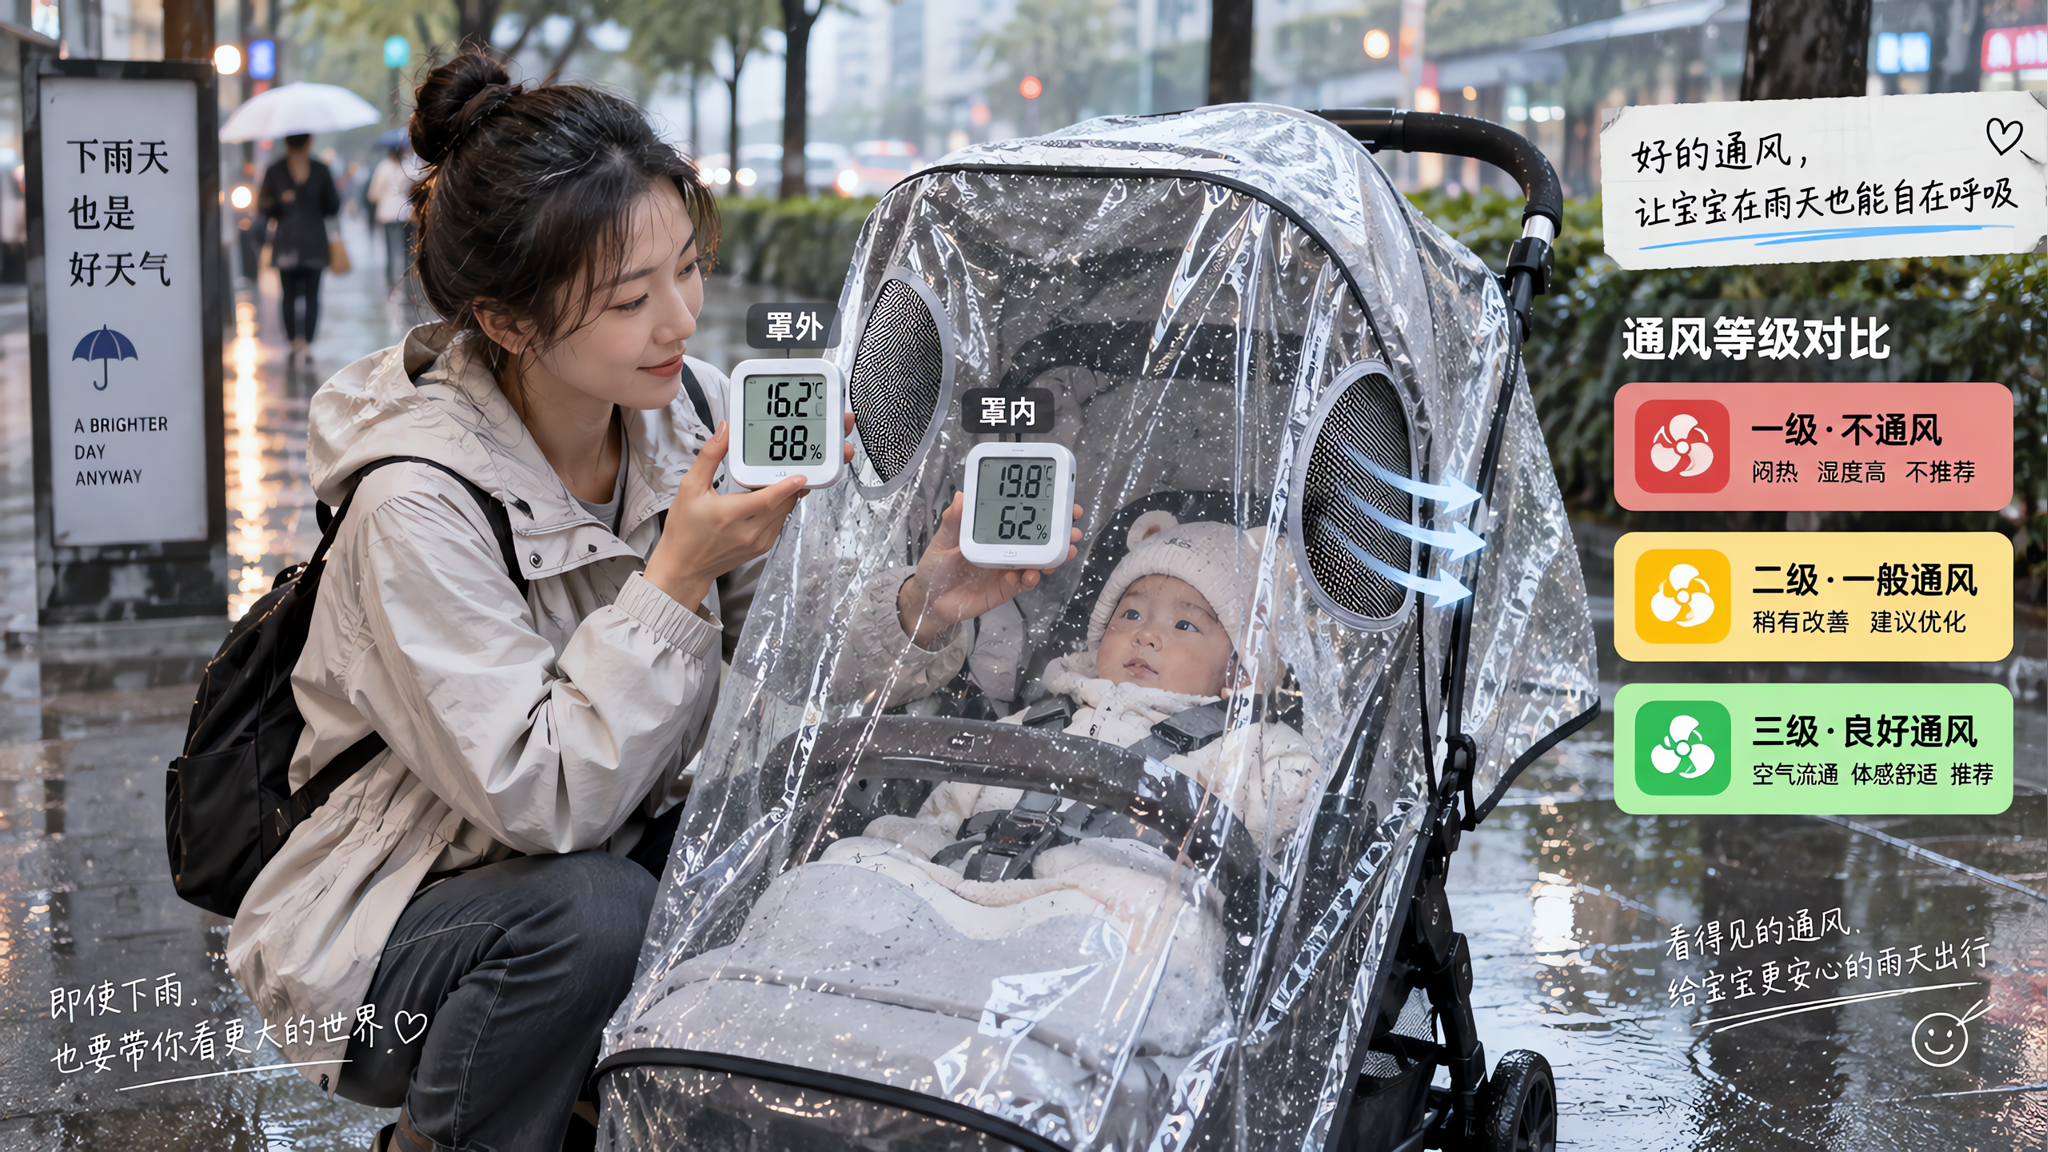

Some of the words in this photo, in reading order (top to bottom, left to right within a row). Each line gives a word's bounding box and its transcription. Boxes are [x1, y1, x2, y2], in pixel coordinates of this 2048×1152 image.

[66, 138, 169, 175] 下雨天
[68, 194, 135, 231] 也是
[69, 250, 171, 287] 好天气
[74, 418, 85, 434] A
[90, 416, 168, 433] BRIGHTER
[75, 443, 106, 460] DAY
[769, 425, 823, 461] 88%
[75, 468, 142, 487] ANYWAY
[998, 505, 1048, 540] 62%
